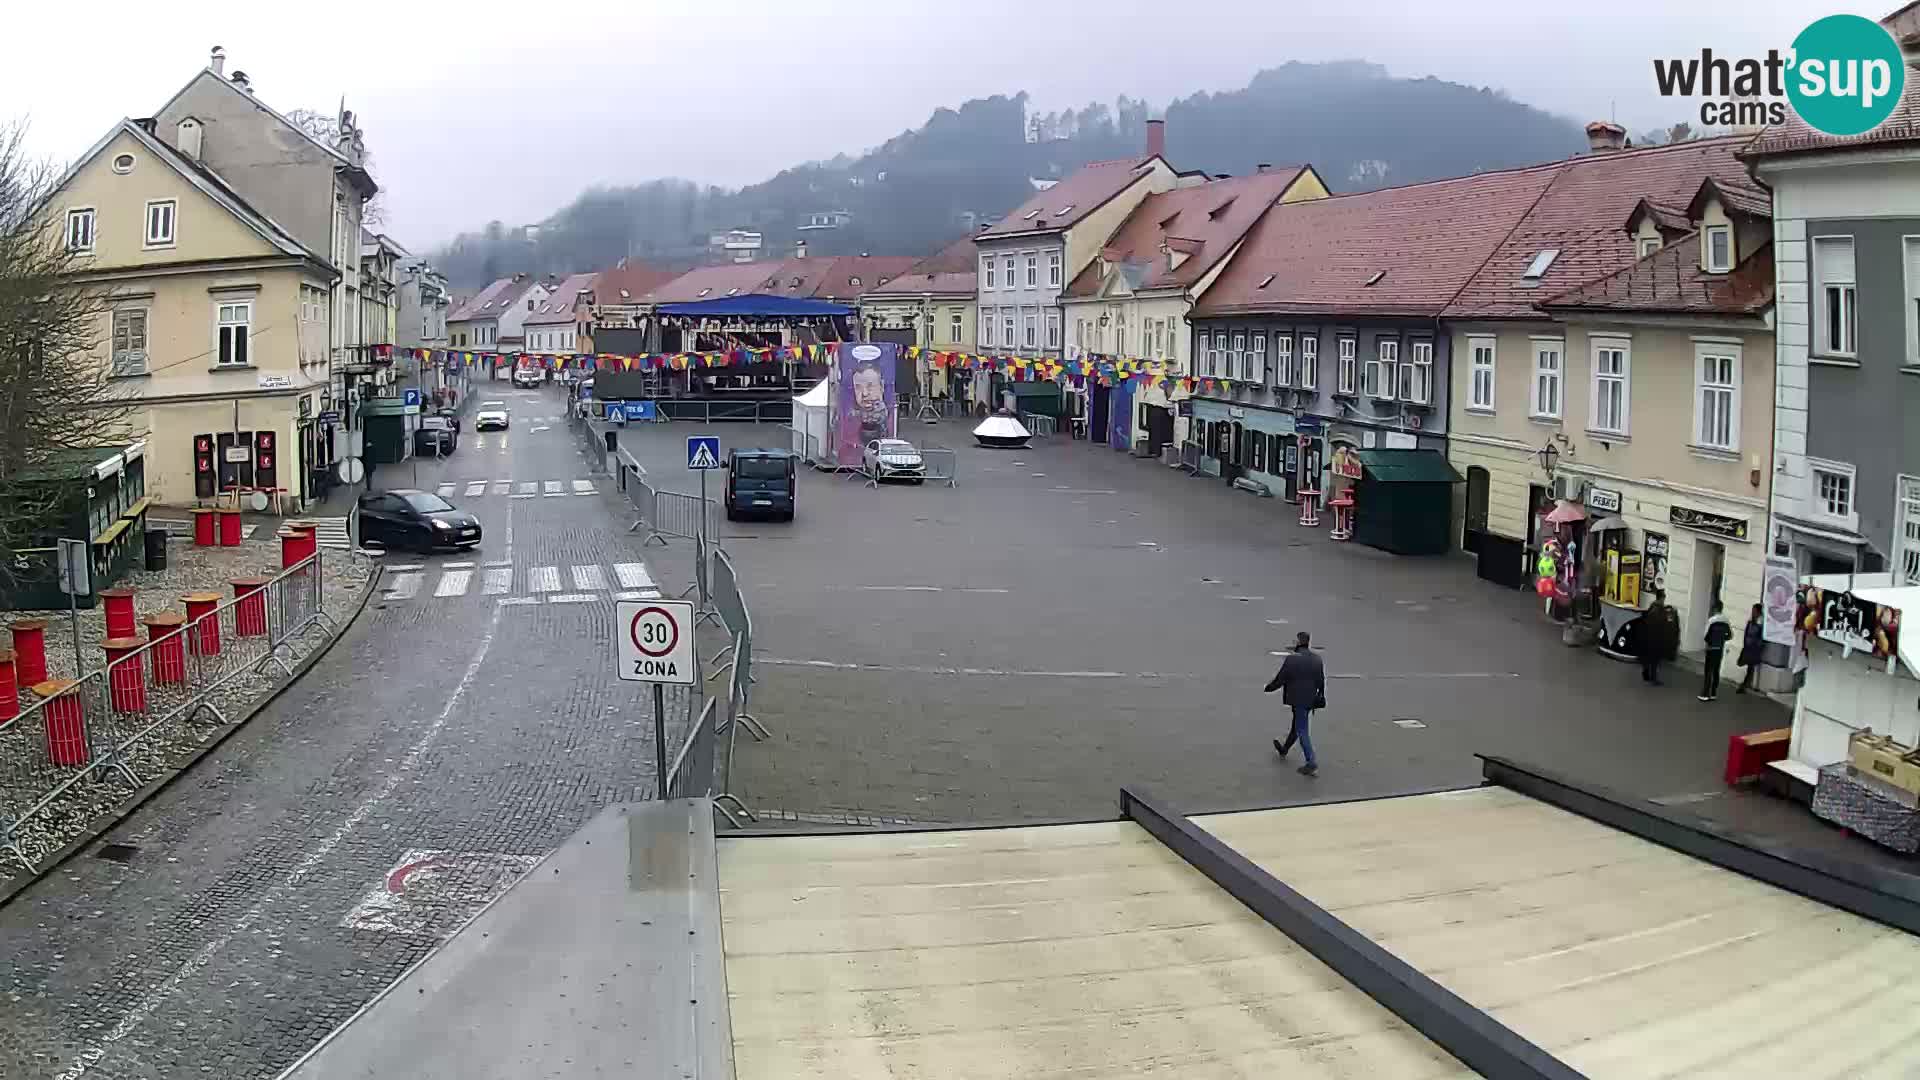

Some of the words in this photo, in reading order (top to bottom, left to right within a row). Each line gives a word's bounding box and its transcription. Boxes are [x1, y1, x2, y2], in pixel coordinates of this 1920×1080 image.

[407, 392, 416, 404] P
[643, 622, 667, 644] 30
[634, 659, 678, 676] ZONA
